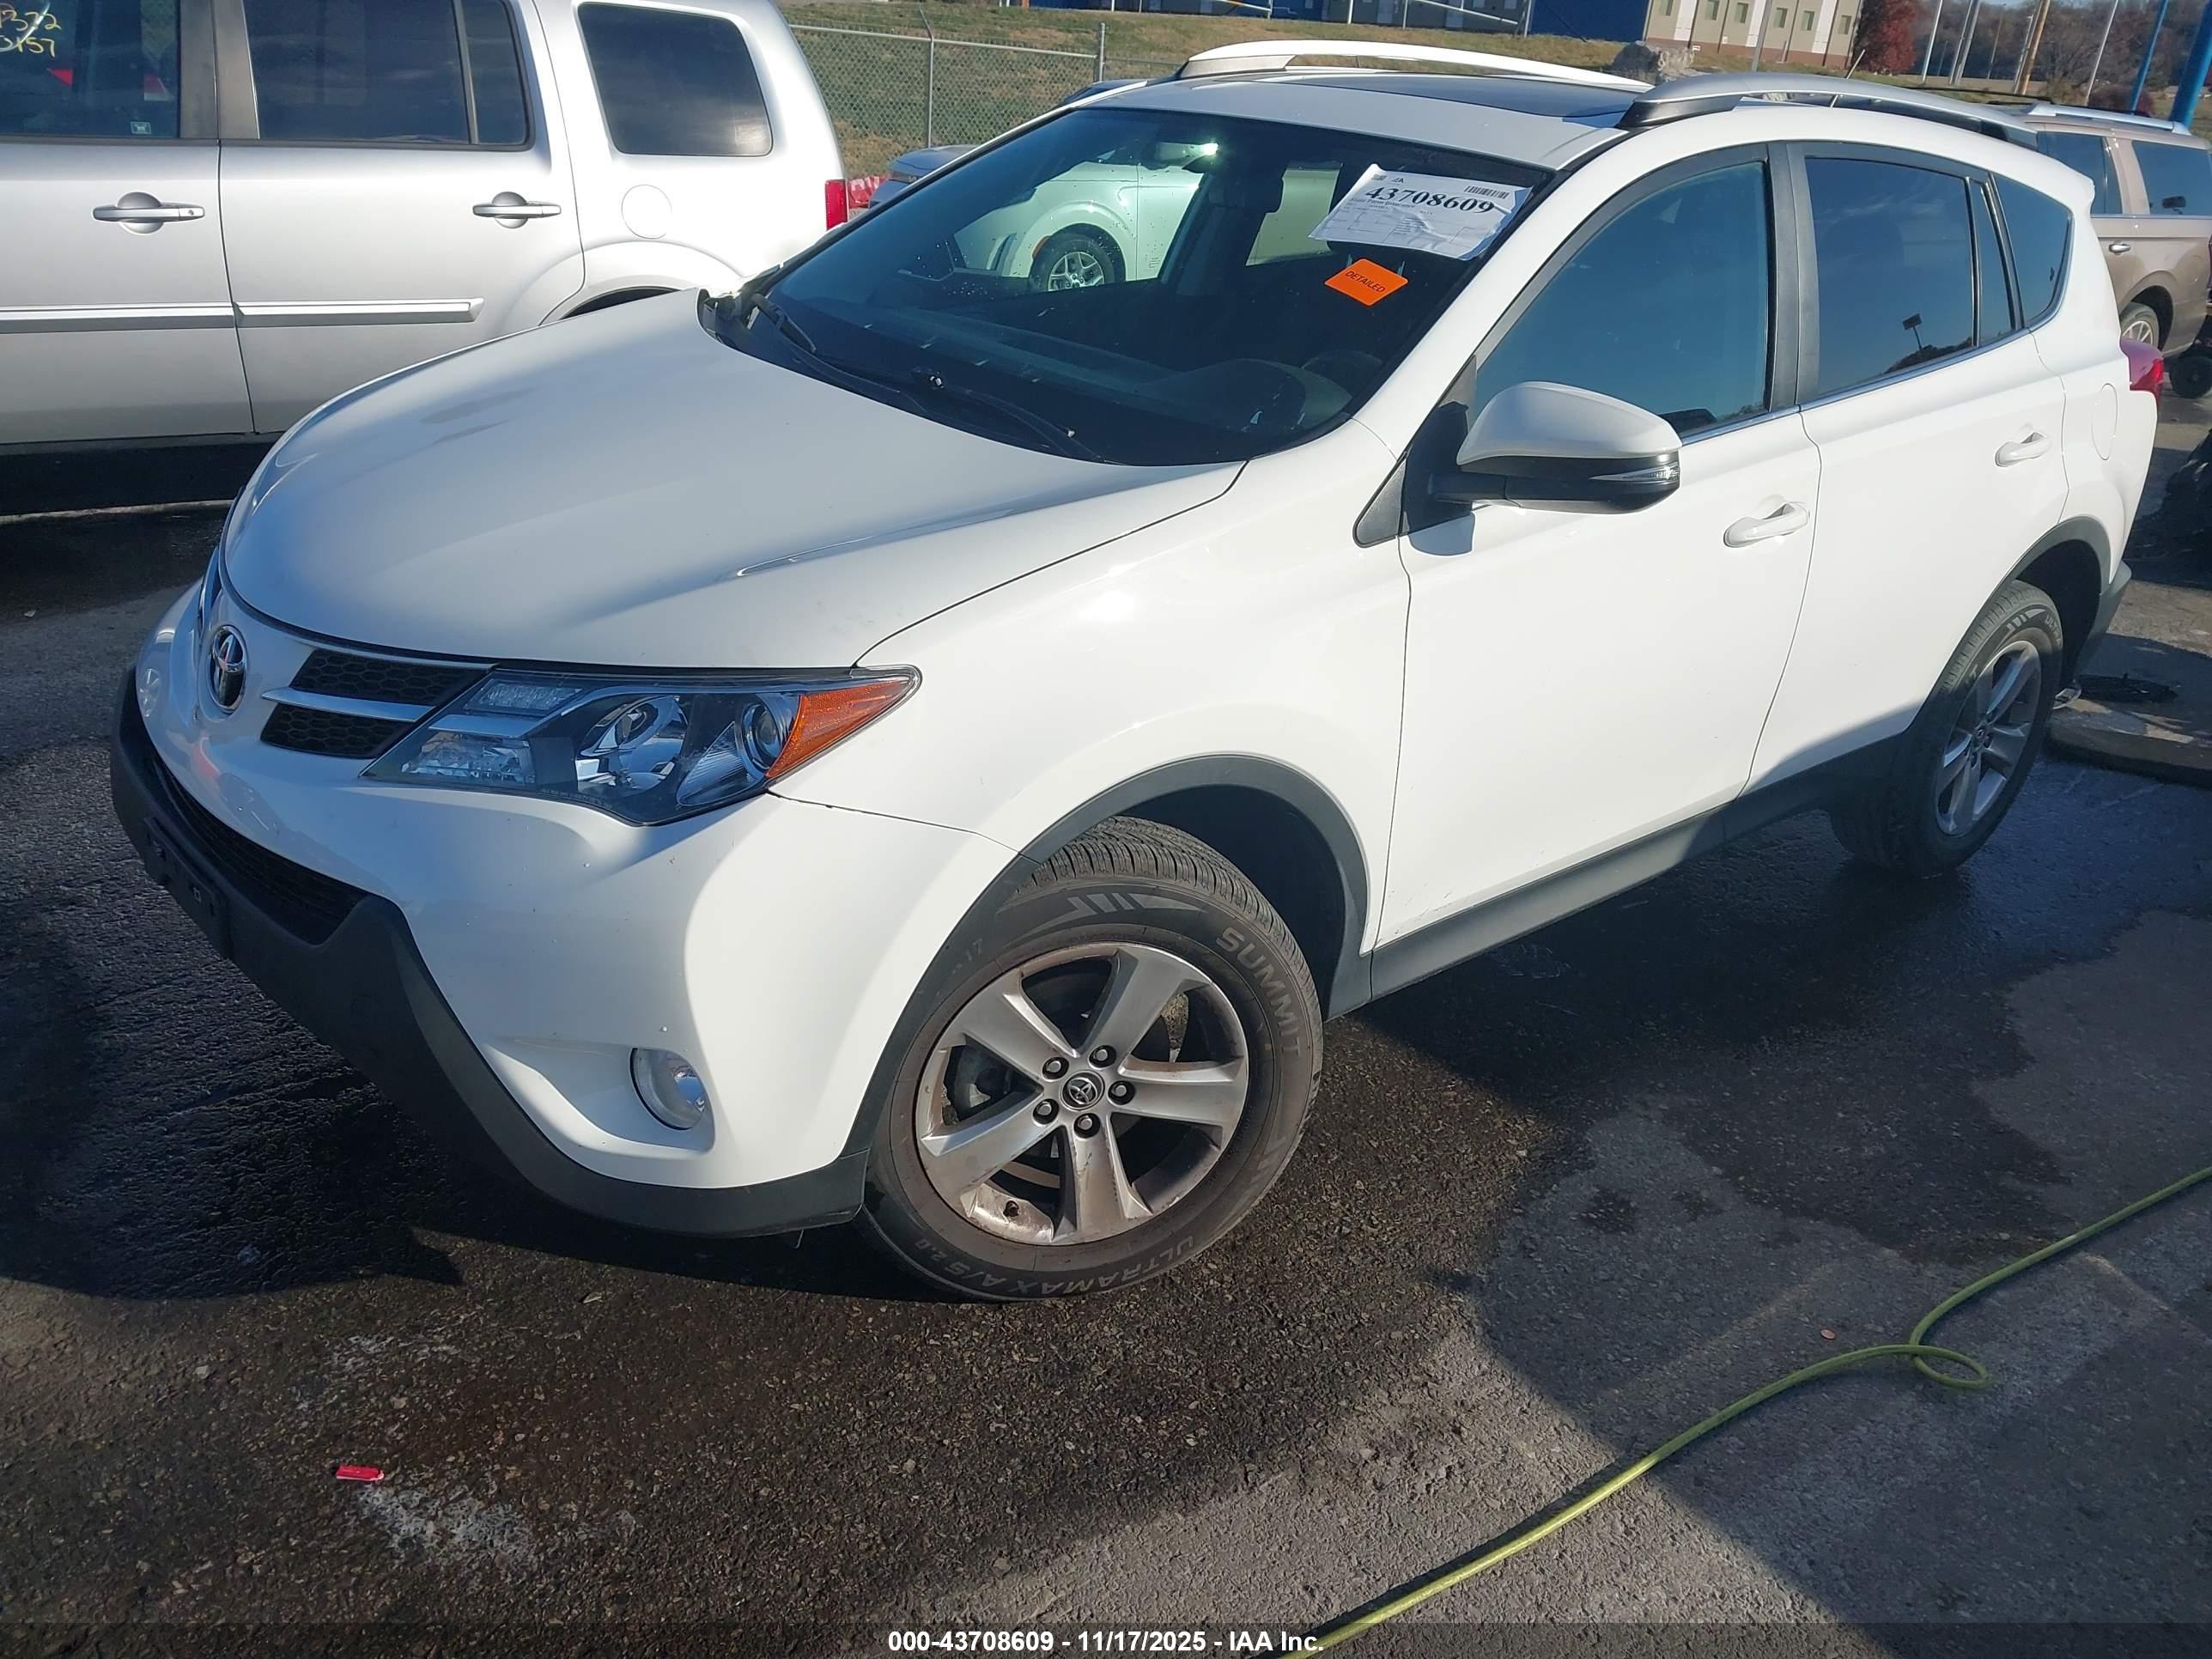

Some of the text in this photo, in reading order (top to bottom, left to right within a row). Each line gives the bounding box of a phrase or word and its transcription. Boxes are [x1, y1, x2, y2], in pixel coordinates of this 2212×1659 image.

[1365, 186, 1494, 214] 43708609
[1346, 270, 1386, 293] DETAILED
[1216, 927, 1300, 1056] SUMMIT
[1006, 1236, 1194, 1295] ULTRAMAX
